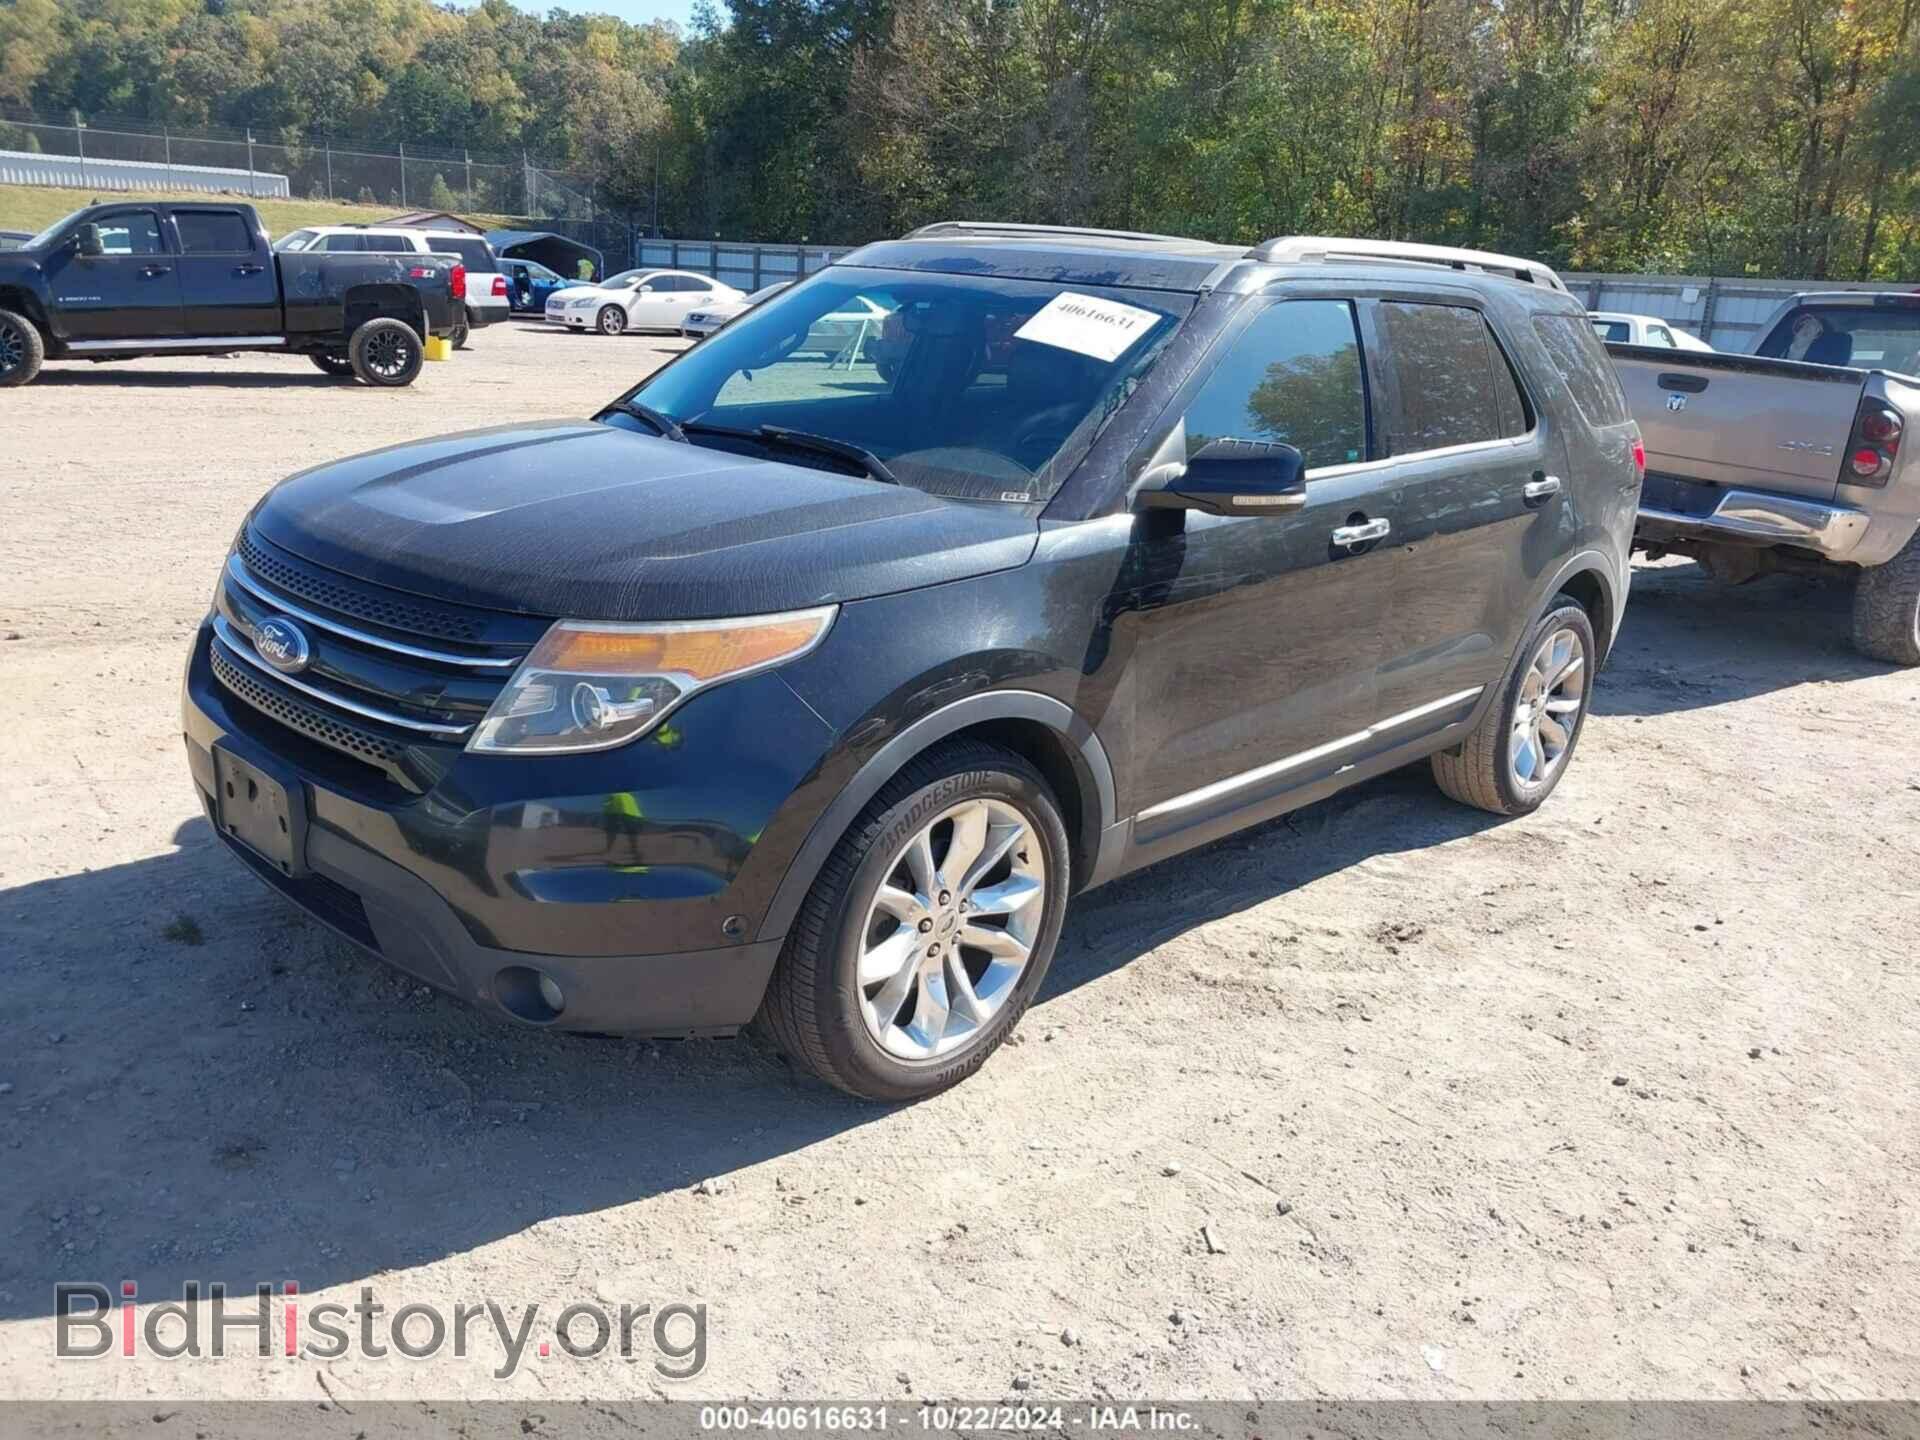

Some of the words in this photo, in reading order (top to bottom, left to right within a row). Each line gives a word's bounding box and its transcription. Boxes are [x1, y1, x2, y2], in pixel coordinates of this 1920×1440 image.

[1057, 303, 1136, 330] 40616631
[258, 624, 290, 659] Ford
[884, 770, 992, 857] BRIDGESTONE
